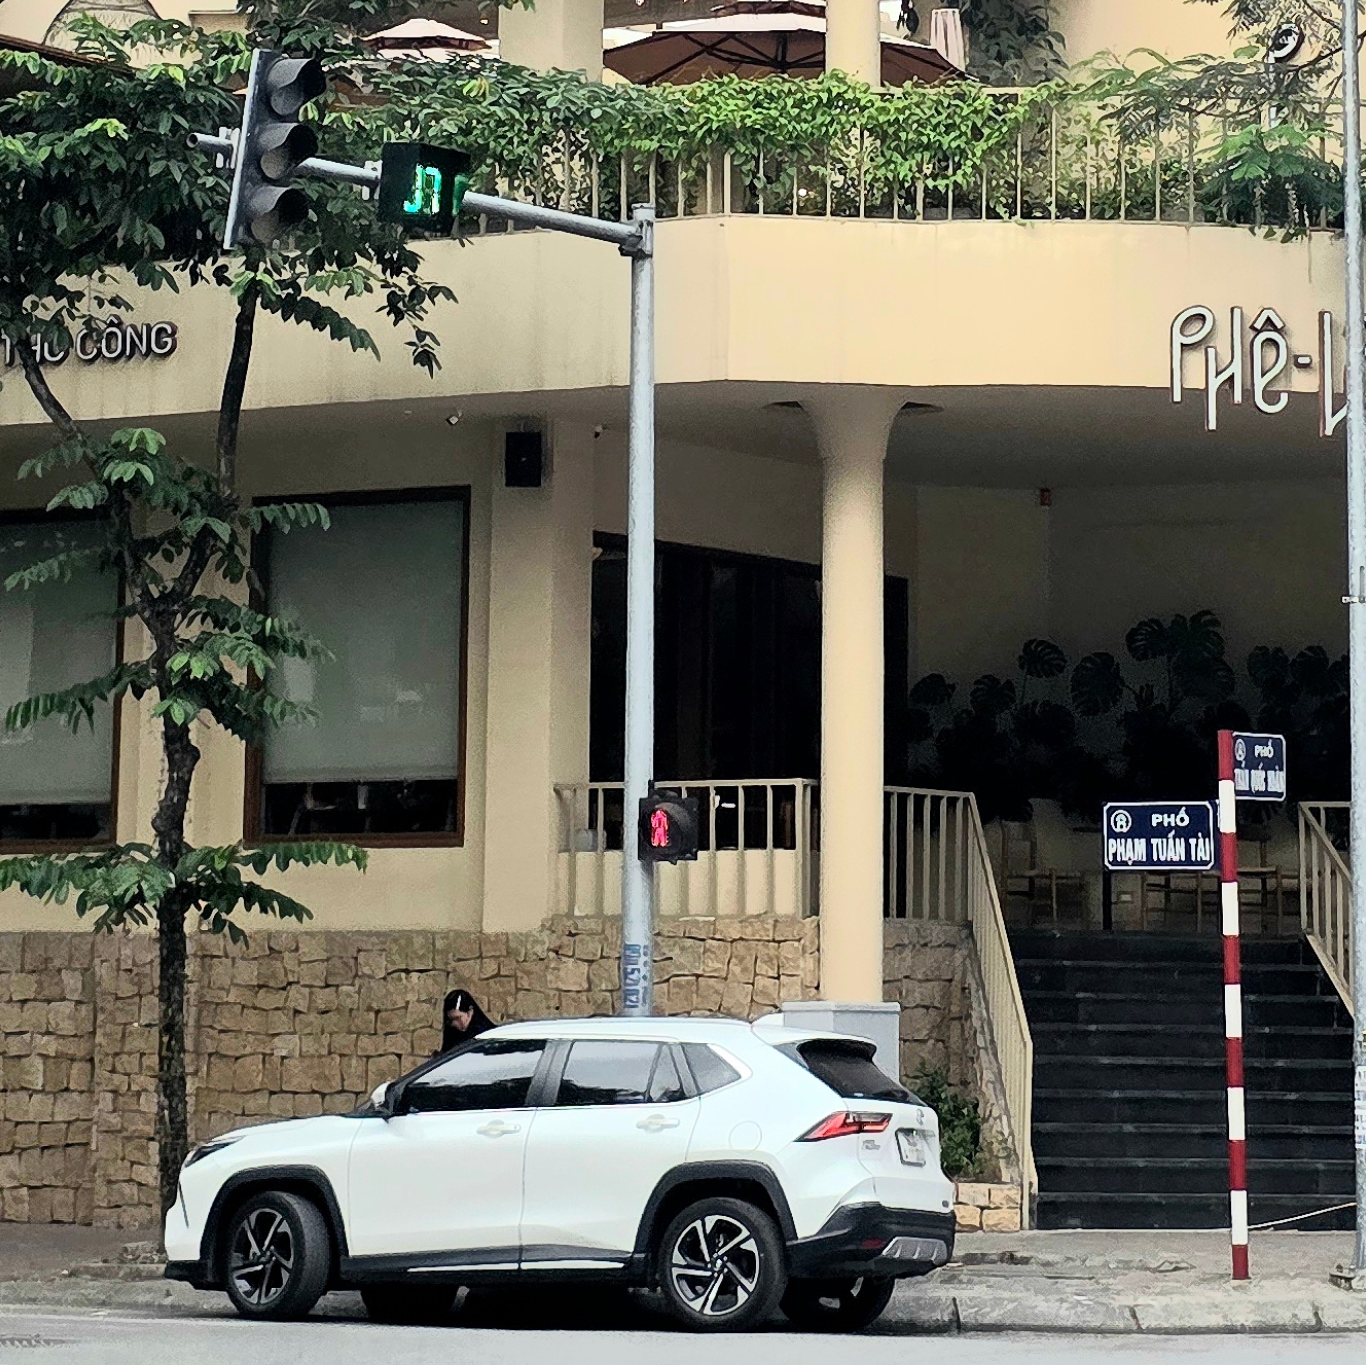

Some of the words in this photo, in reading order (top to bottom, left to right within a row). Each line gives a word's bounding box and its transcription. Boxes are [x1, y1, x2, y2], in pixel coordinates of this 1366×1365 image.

[76, 316, 178, 361] CÔNG
[1254, 739, 1275, 758] PHỐ
[1151, 806, 1190, 827] PHỐ
[1108, 837, 1147, 866] PHẠM
[1150, 829, 1186, 862] TUẤN
[1188, 831, 1211, 862] TÀI
